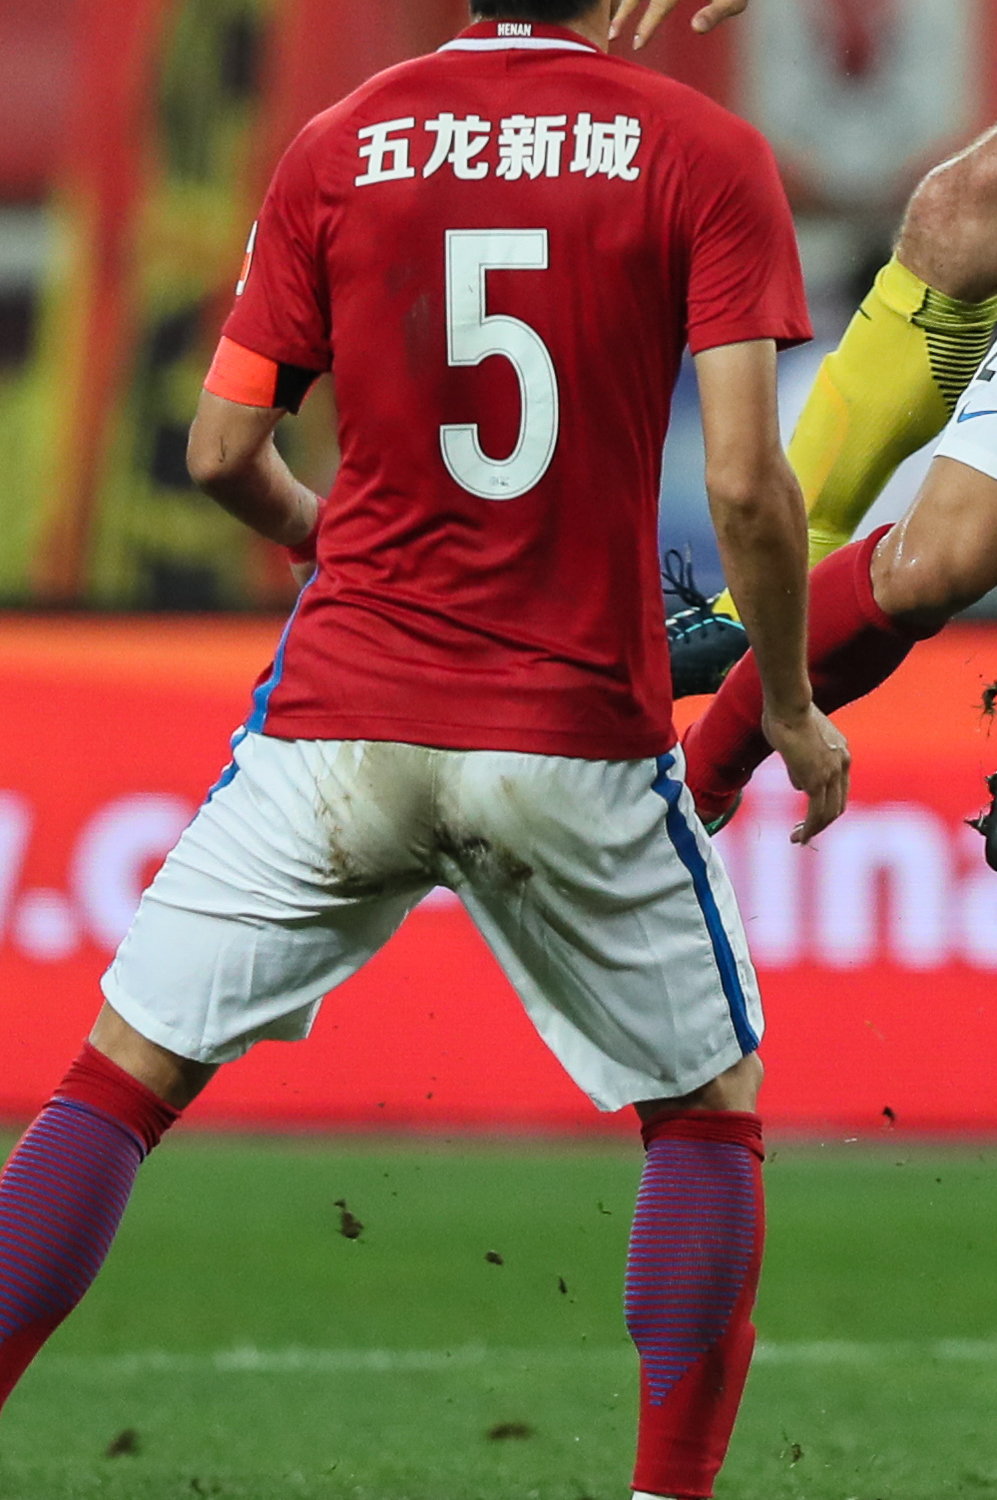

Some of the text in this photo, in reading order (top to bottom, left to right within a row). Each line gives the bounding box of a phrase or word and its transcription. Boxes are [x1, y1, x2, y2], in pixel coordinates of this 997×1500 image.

[497, 22, 532, 37] HENAN
[354, 112, 642, 187] 五龙新城
[439, 228, 560, 501] 5
